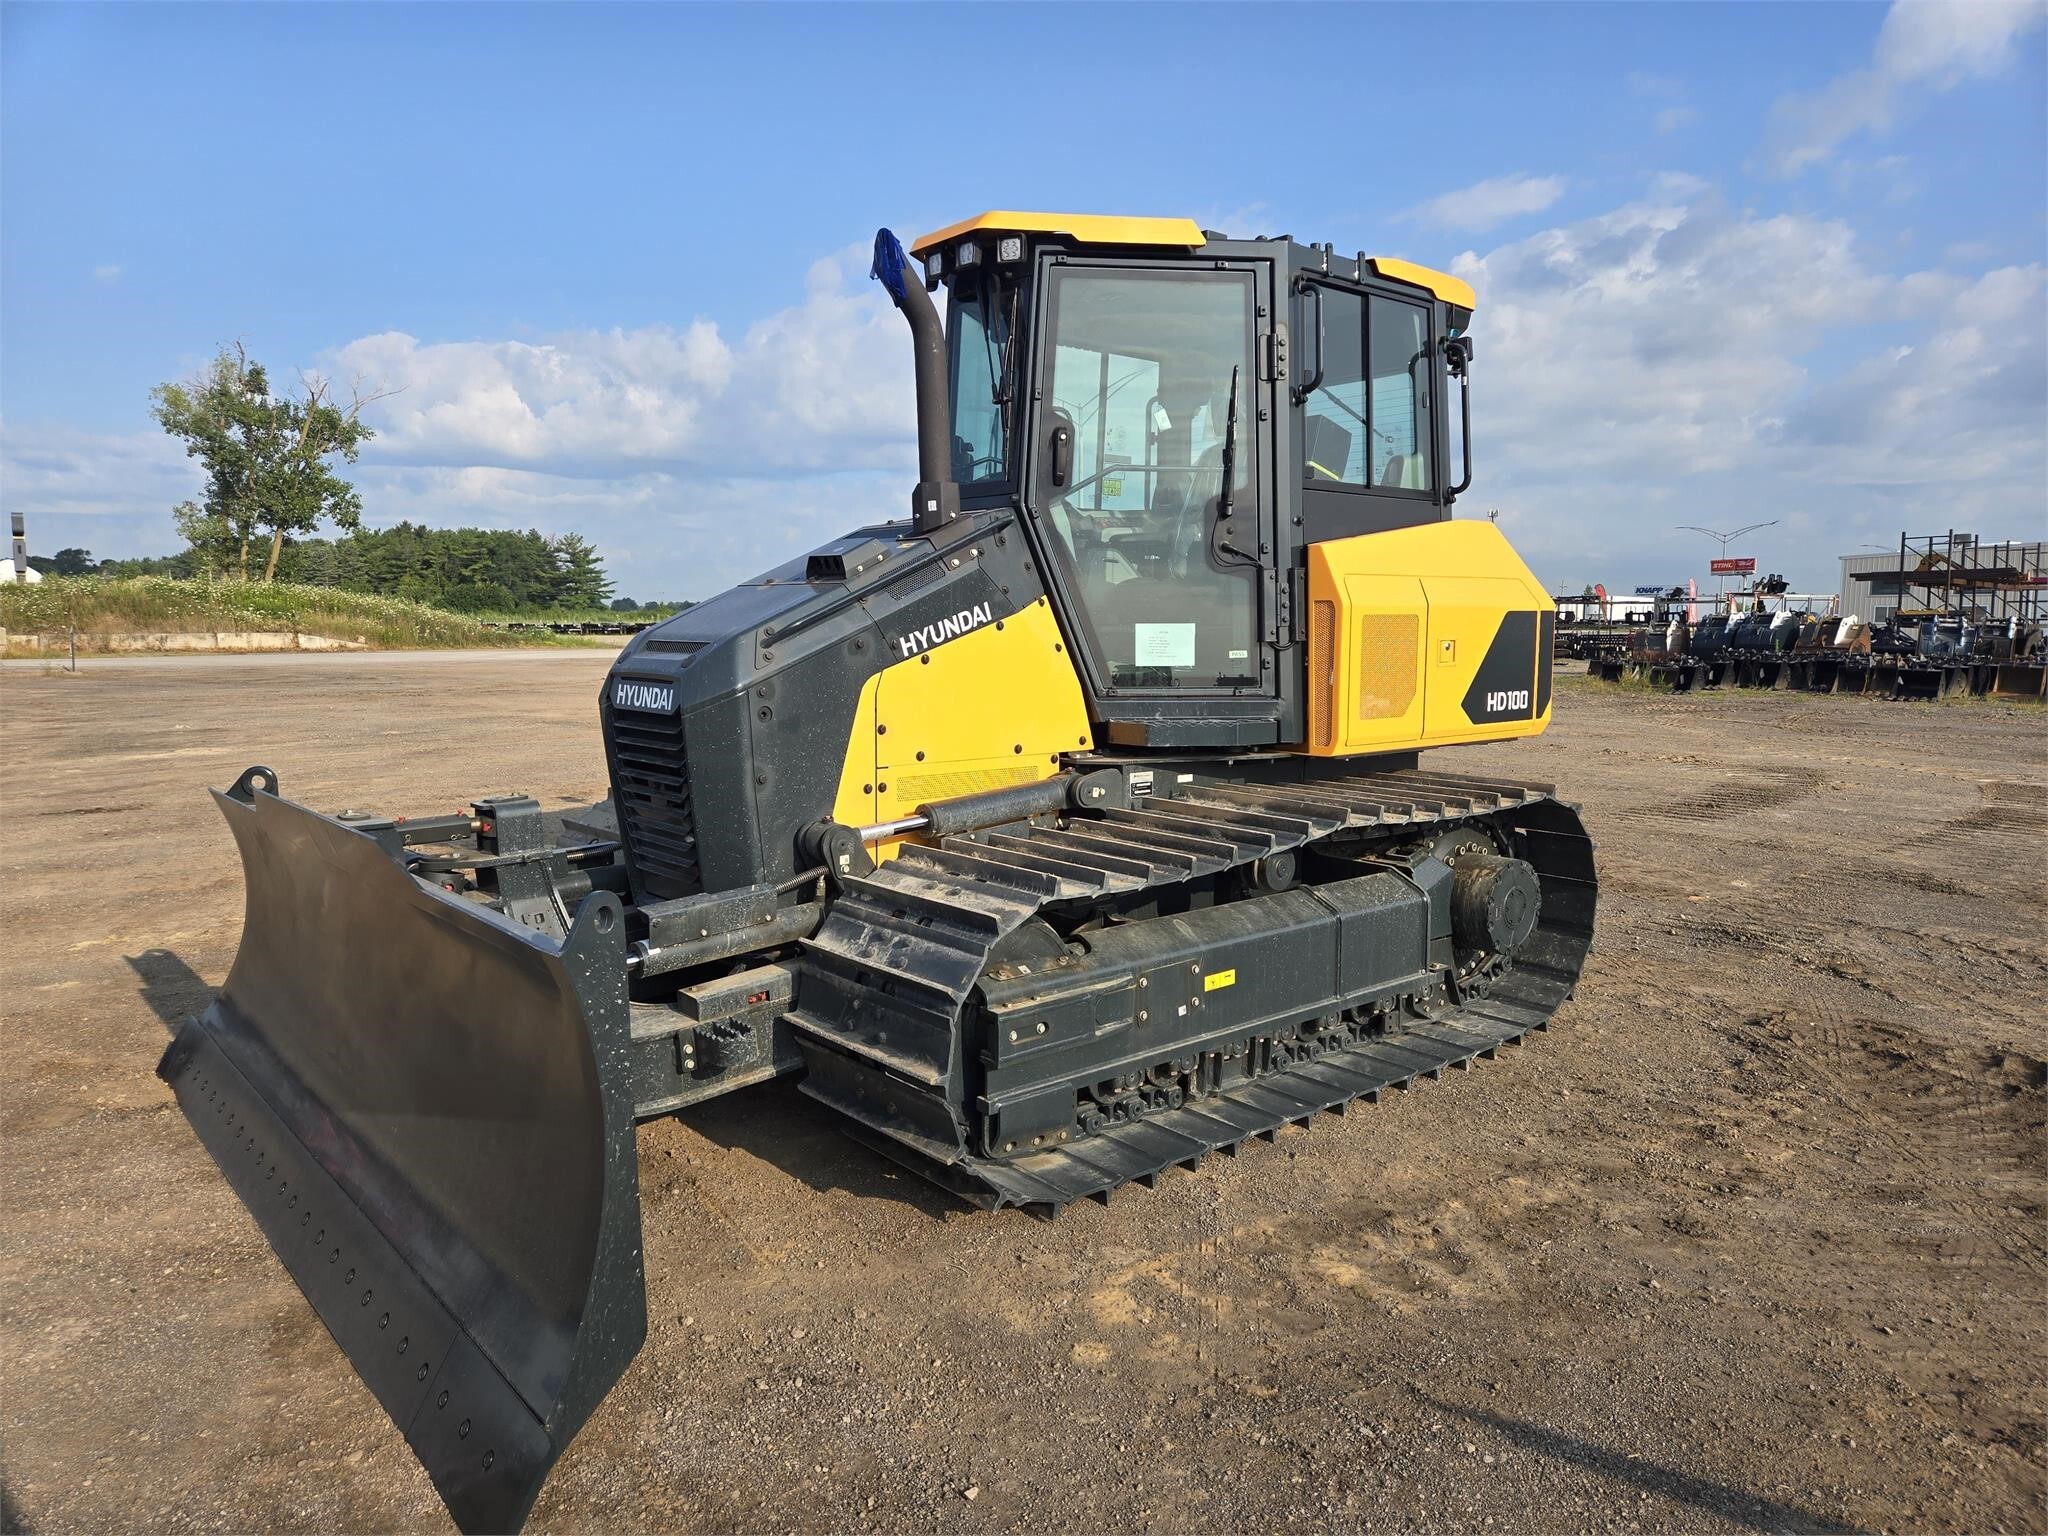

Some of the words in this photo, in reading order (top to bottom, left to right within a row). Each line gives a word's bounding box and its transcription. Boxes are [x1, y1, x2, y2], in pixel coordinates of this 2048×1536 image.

[899, 601, 992, 657] HYUNDAI
[616, 683, 674, 711] HYUNDAI
[1486, 690, 1529, 712] HD100
